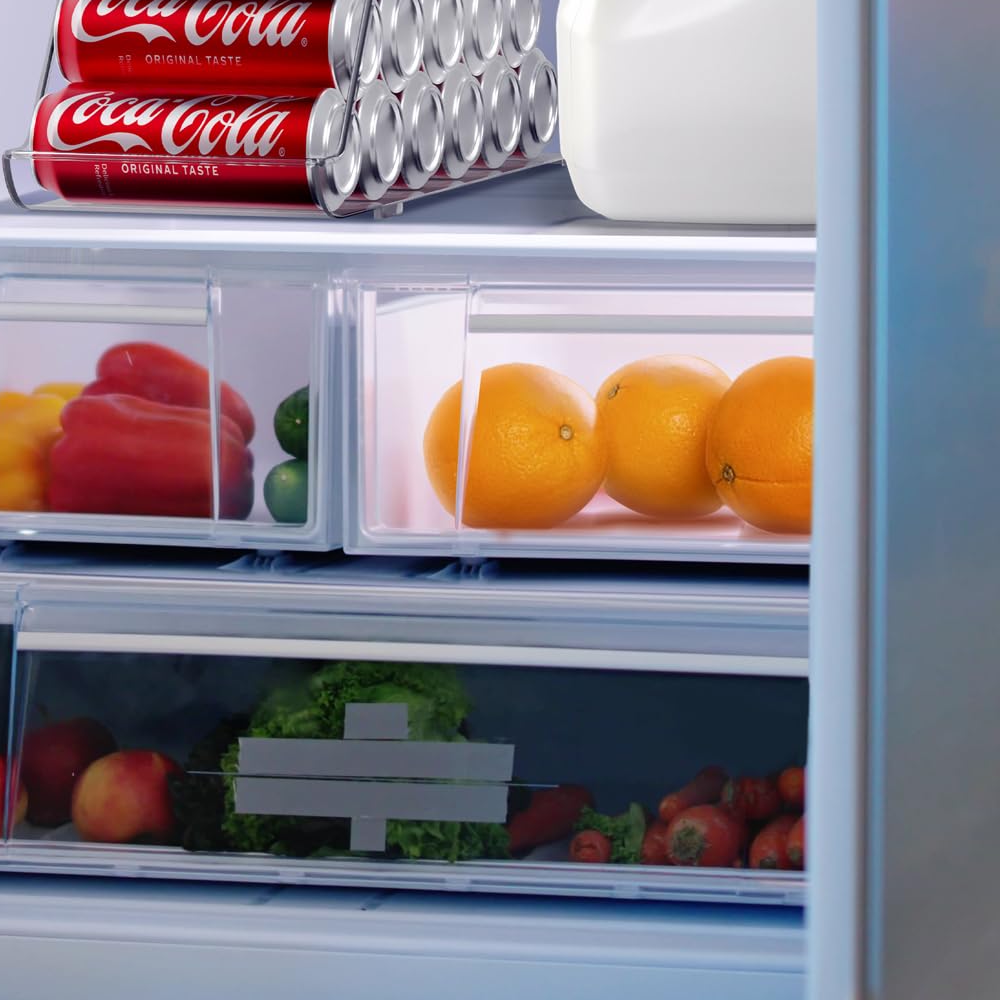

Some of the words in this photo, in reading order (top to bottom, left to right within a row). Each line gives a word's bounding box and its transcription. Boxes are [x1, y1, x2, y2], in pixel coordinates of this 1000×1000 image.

[145, 54, 202, 66] ORIGINAL
[205, 56, 243, 66] TASTE
[47, 91, 291, 156] Coca-Cola
[121, 163, 179, 176] ORIGINAL
[182, 165, 219, 176] TASTE
